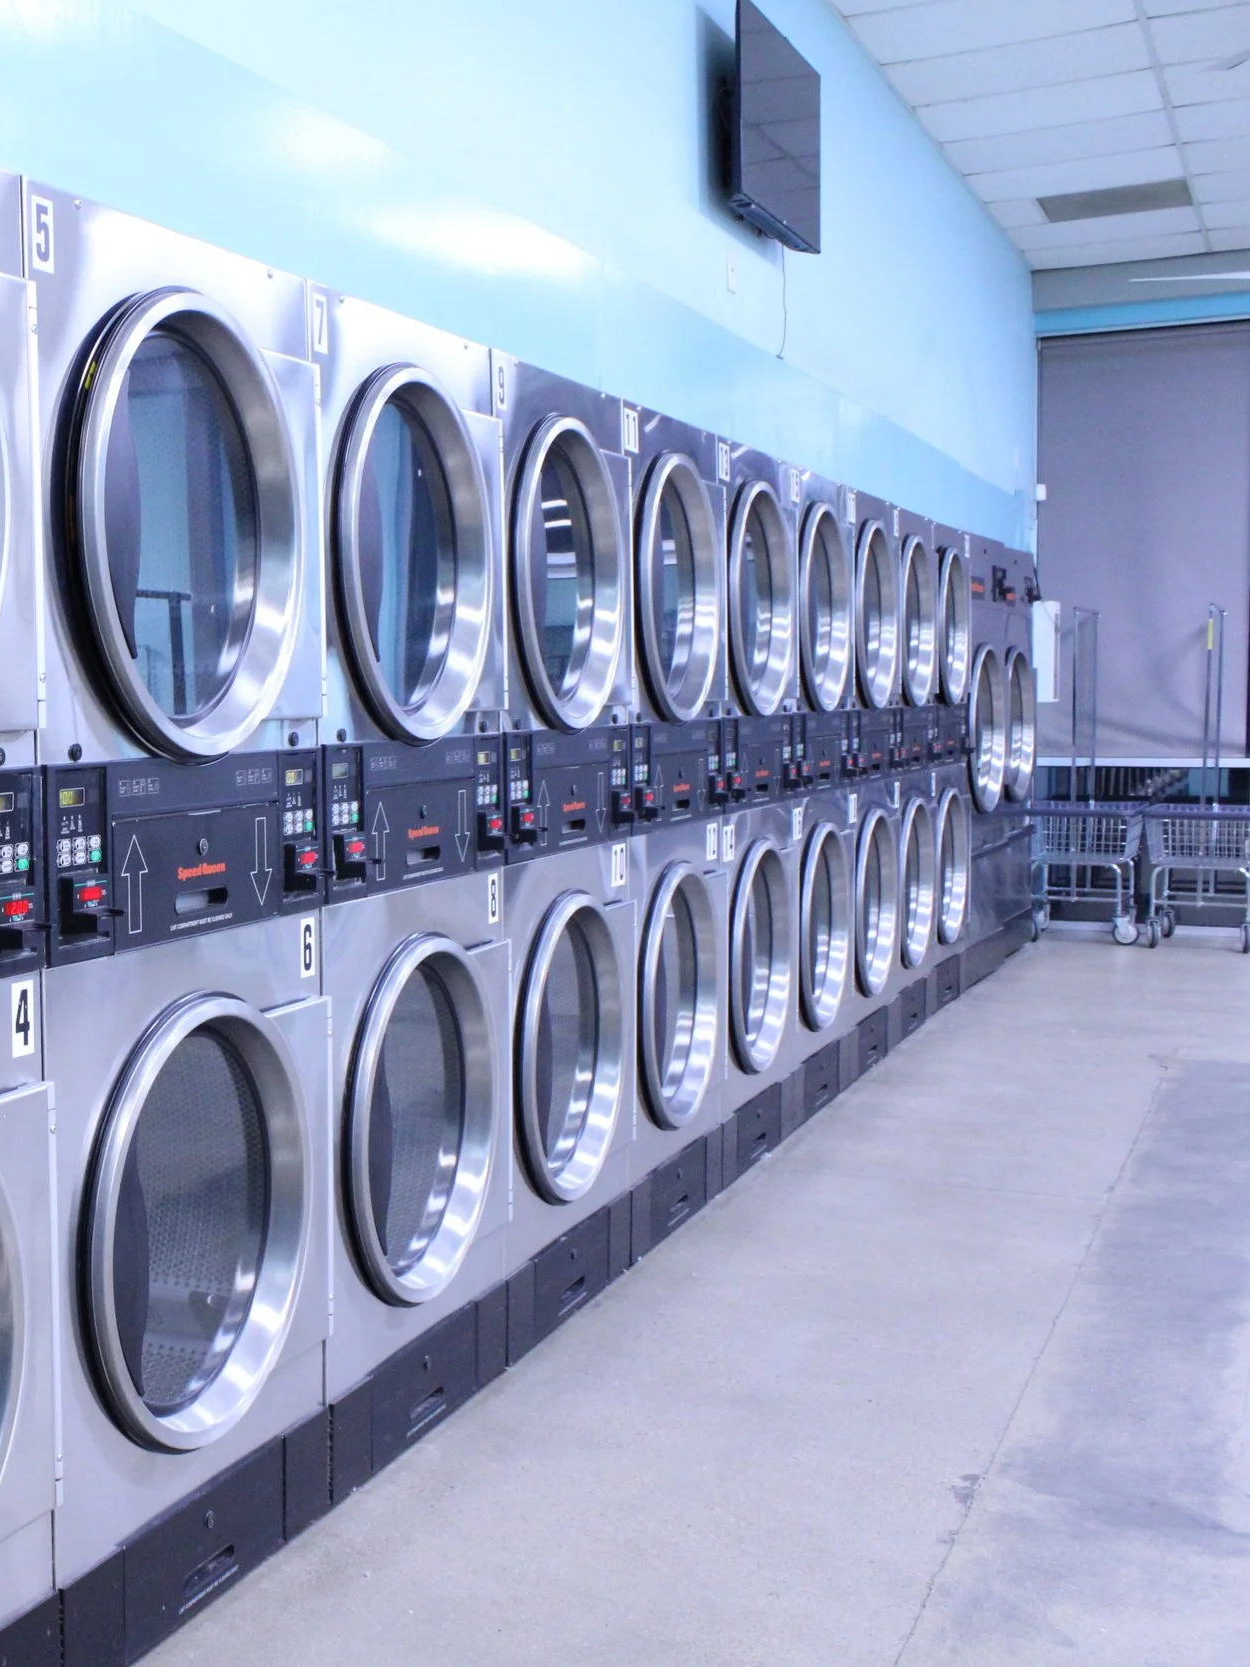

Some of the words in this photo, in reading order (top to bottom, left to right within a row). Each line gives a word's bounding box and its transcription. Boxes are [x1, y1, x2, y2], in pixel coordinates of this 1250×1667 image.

[36, 203, 50, 262] 5
[315, 299, 324, 345] 7
[498, 366, 504, 404] 9
[491, 879, 496, 917] 8
[304, 924, 312, 971] 6
[16, 989, 30, 1046] 4
